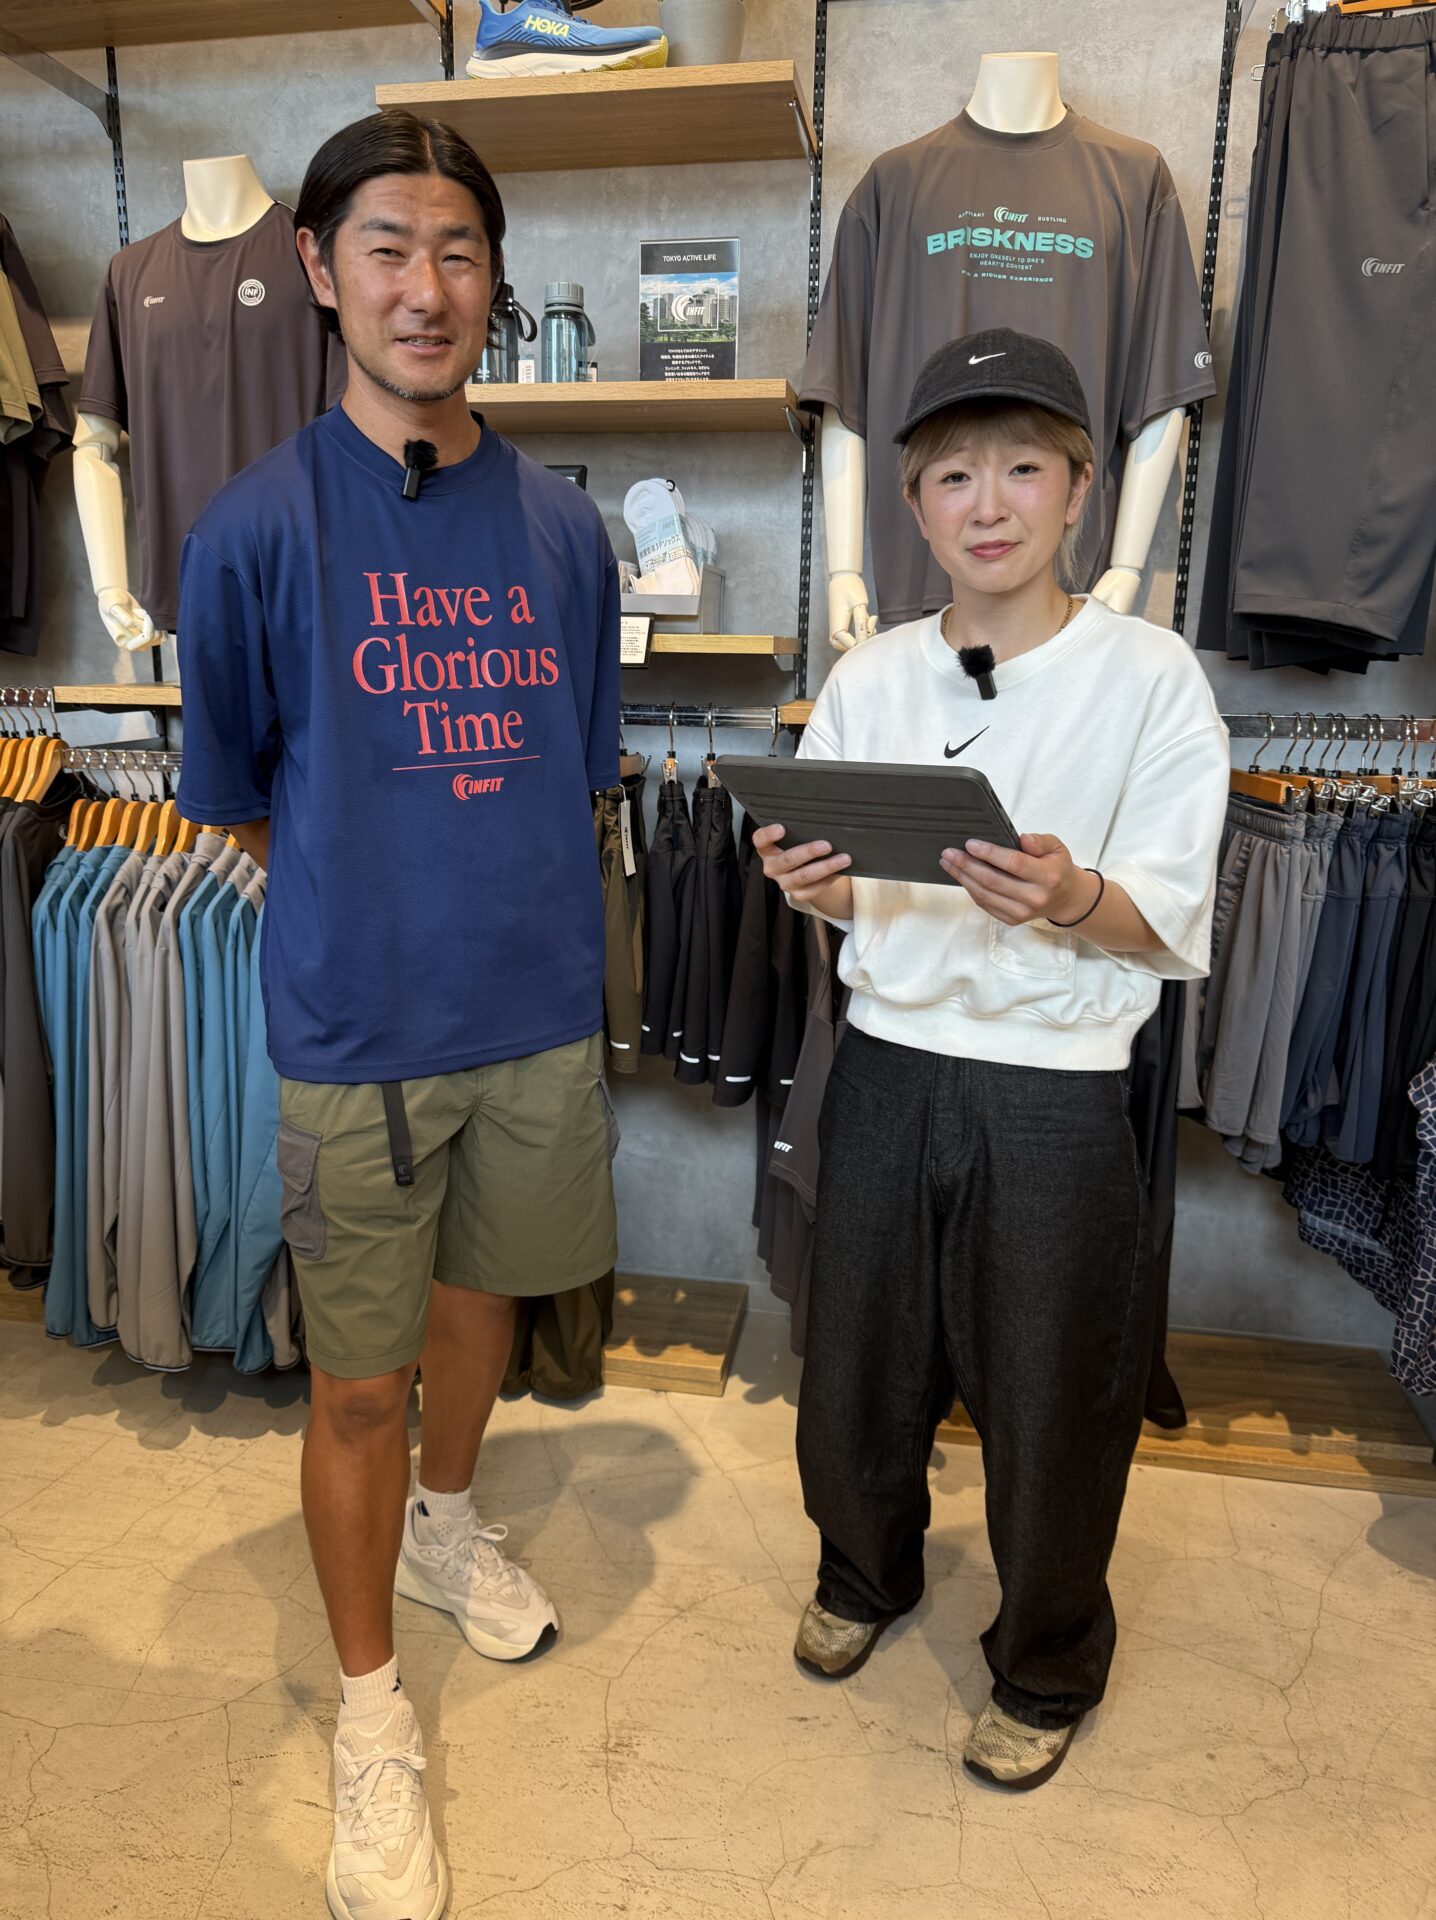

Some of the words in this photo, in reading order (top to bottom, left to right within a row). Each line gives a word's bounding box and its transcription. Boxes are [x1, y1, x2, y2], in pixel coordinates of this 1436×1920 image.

[524, 14, 570, 38] HOKA
[1003, 211, 1029, 223] INFIT
[927, 226, 1094, 259] BRISKNESS
[682, 254, 703, 262] ACTIVE
[703, 253, 717, 261] LIFE
[990, 253, 1016, 262] ONESELF
[1006, 262, 1033, 270] CONTENT
[1374, 262, 1405, 274] INFIT
[244, 287, 258, 297] INF
[686, 306, 706, 316] INFIT
[362, 572, 493, 627] Have
[507, 585, 536, 624] a
[352, 633, 560, 695] Glorious
[403, 699, 525, 755] Time
[468, 777, 505, 794] INFIT
